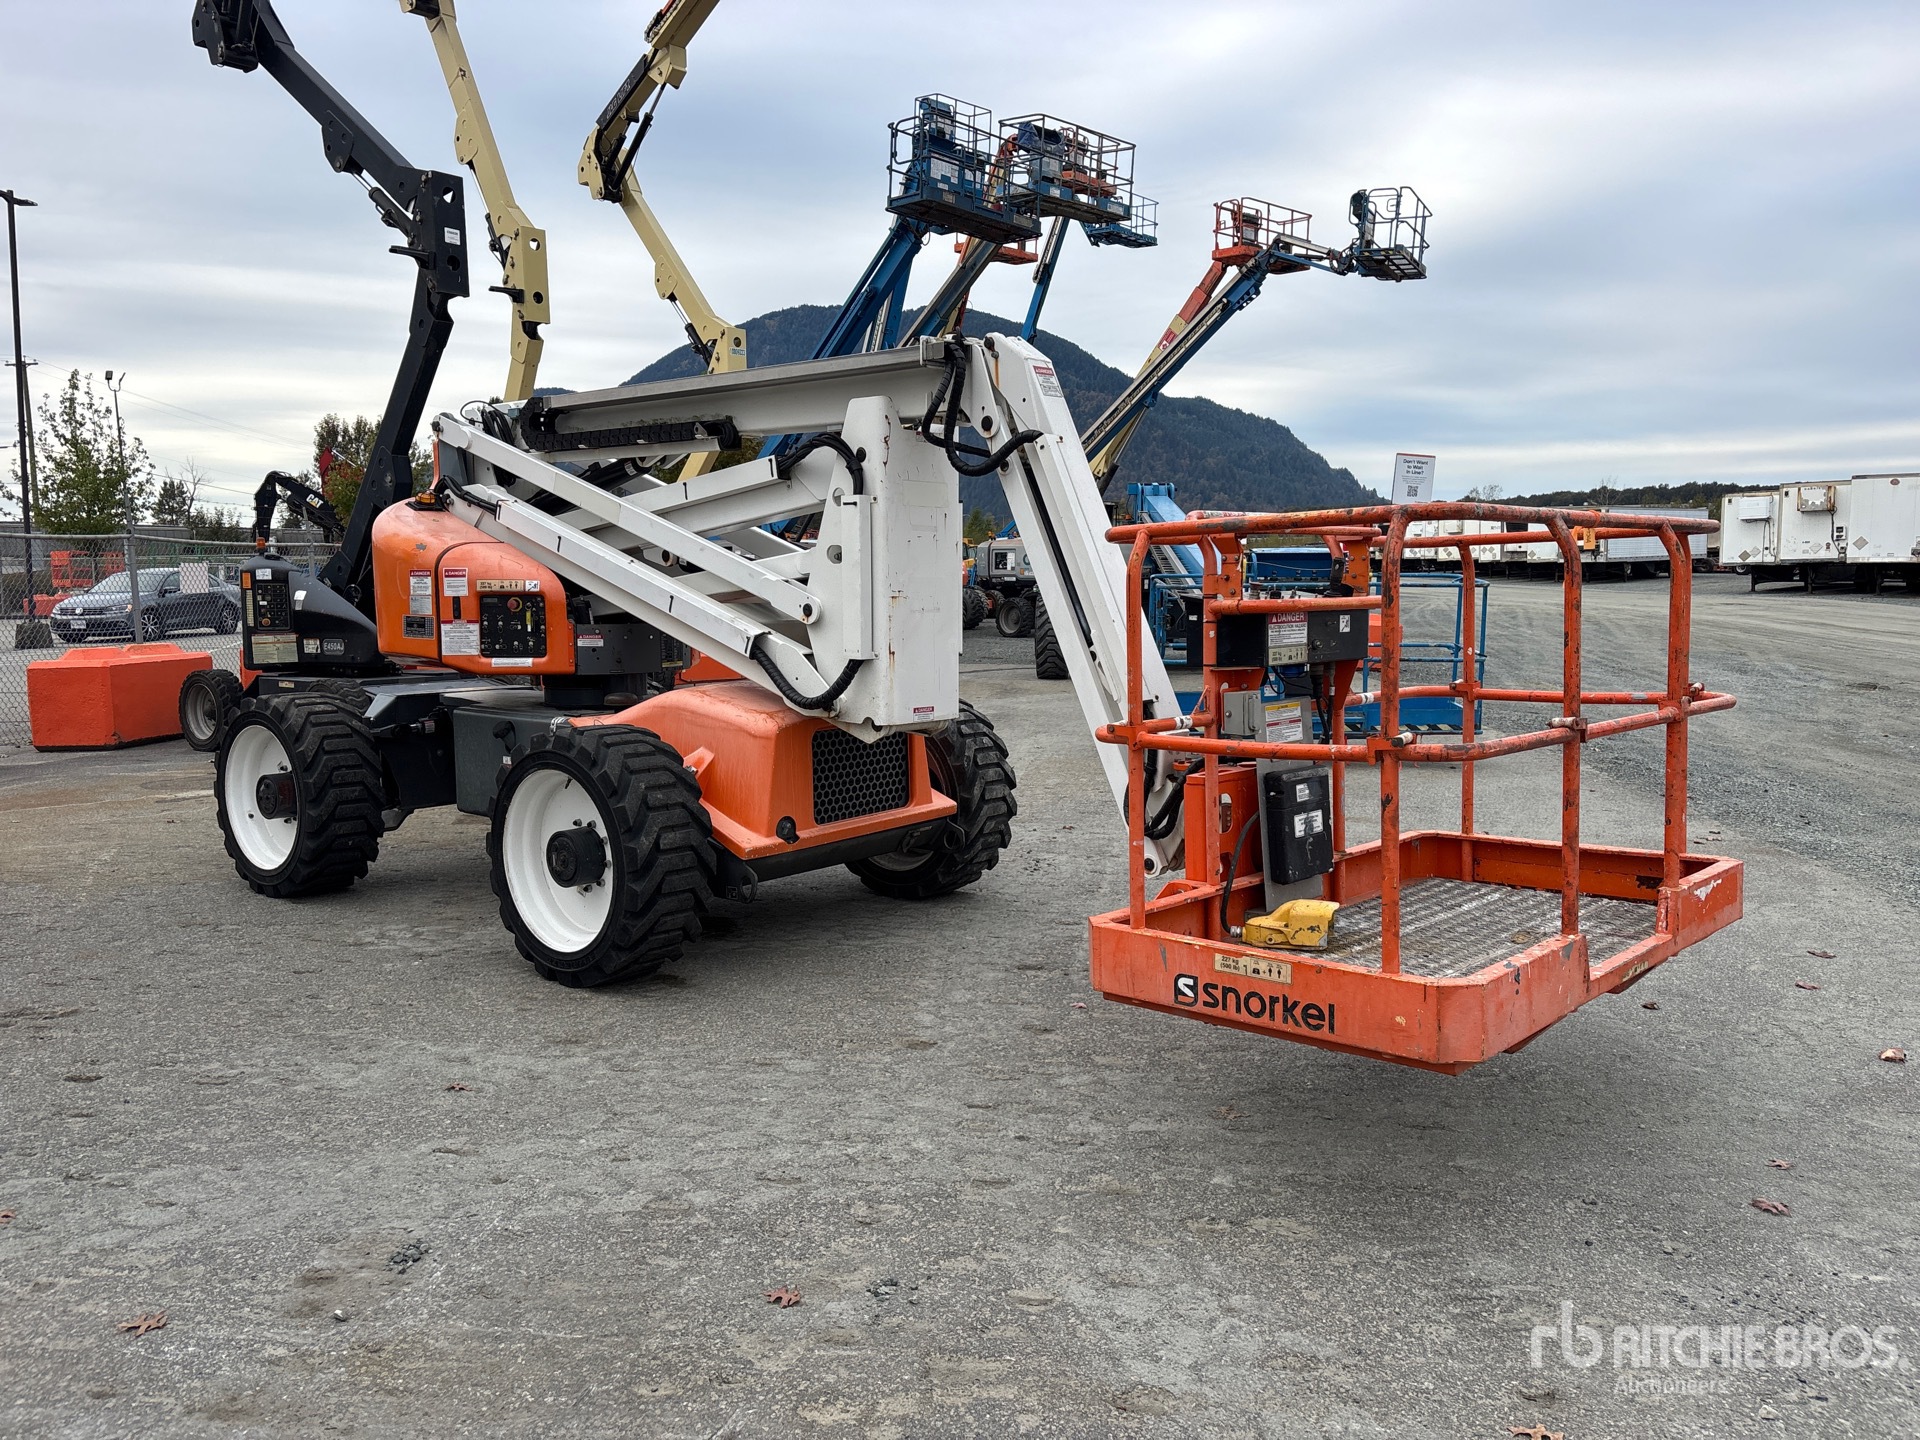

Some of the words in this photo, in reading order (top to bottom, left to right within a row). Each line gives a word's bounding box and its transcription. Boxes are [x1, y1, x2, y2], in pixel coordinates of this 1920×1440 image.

[306, 493, 324, 508] CAT
[1277, 613, 1305, 622] DANGER
[324, 642, 344, 650] E450AJ
[1232, 957, 1240, 965] kg
[1202, 982, 1335, 1034] snorkel
